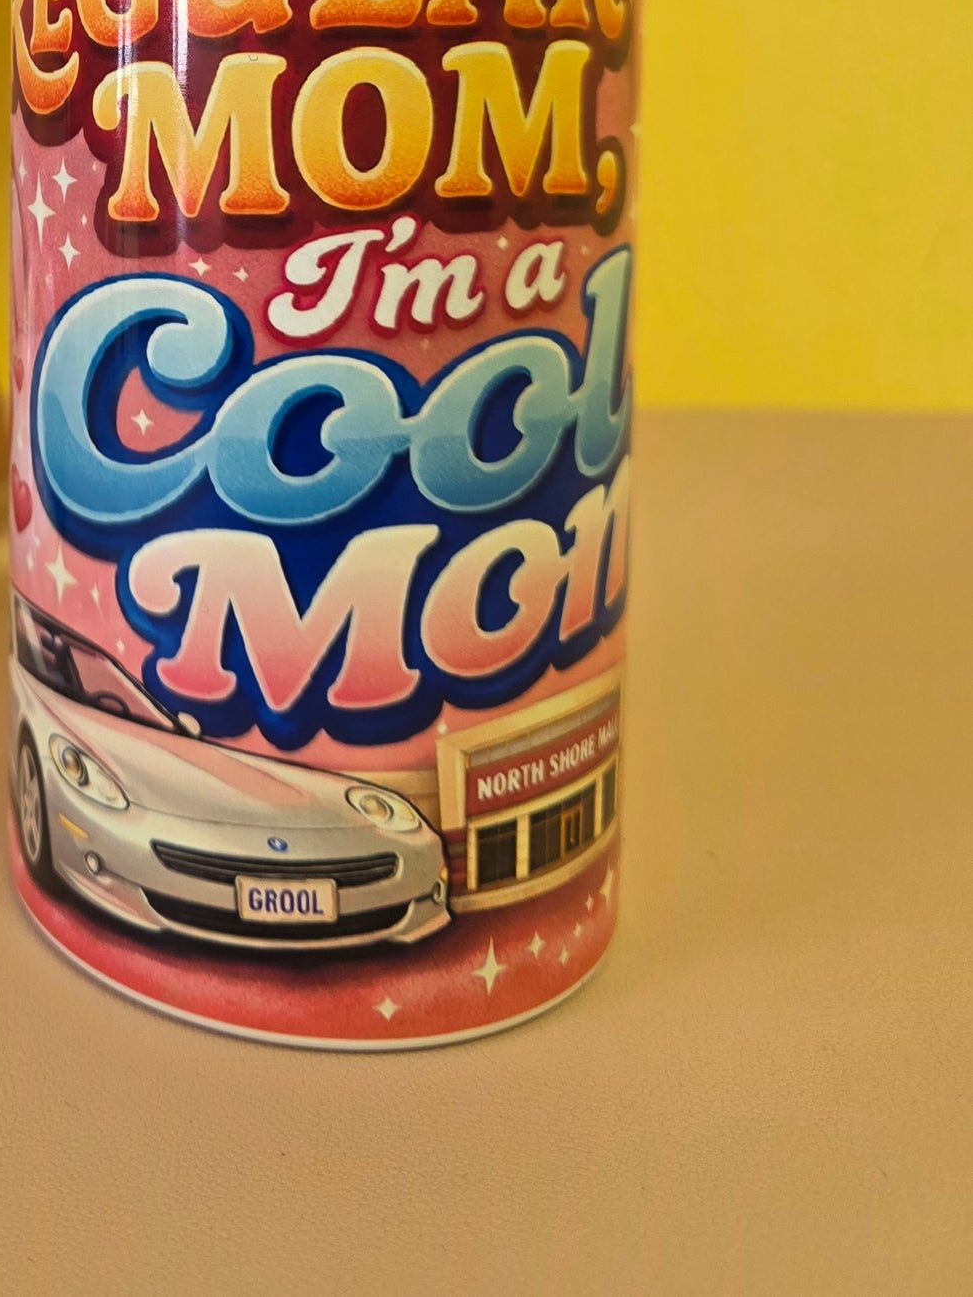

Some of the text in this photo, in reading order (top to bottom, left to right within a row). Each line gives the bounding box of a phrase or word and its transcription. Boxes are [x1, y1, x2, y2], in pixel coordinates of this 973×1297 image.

[92, 39, 617, 222] MOM,
[267, 215, 566, 338] I'm a
[36, 250, 632, 525] Cool
[476, 758, 544, 801] NORTH
[549, 733, 595, 777] SHORE
[248, 886, 325, 915] GROOL
